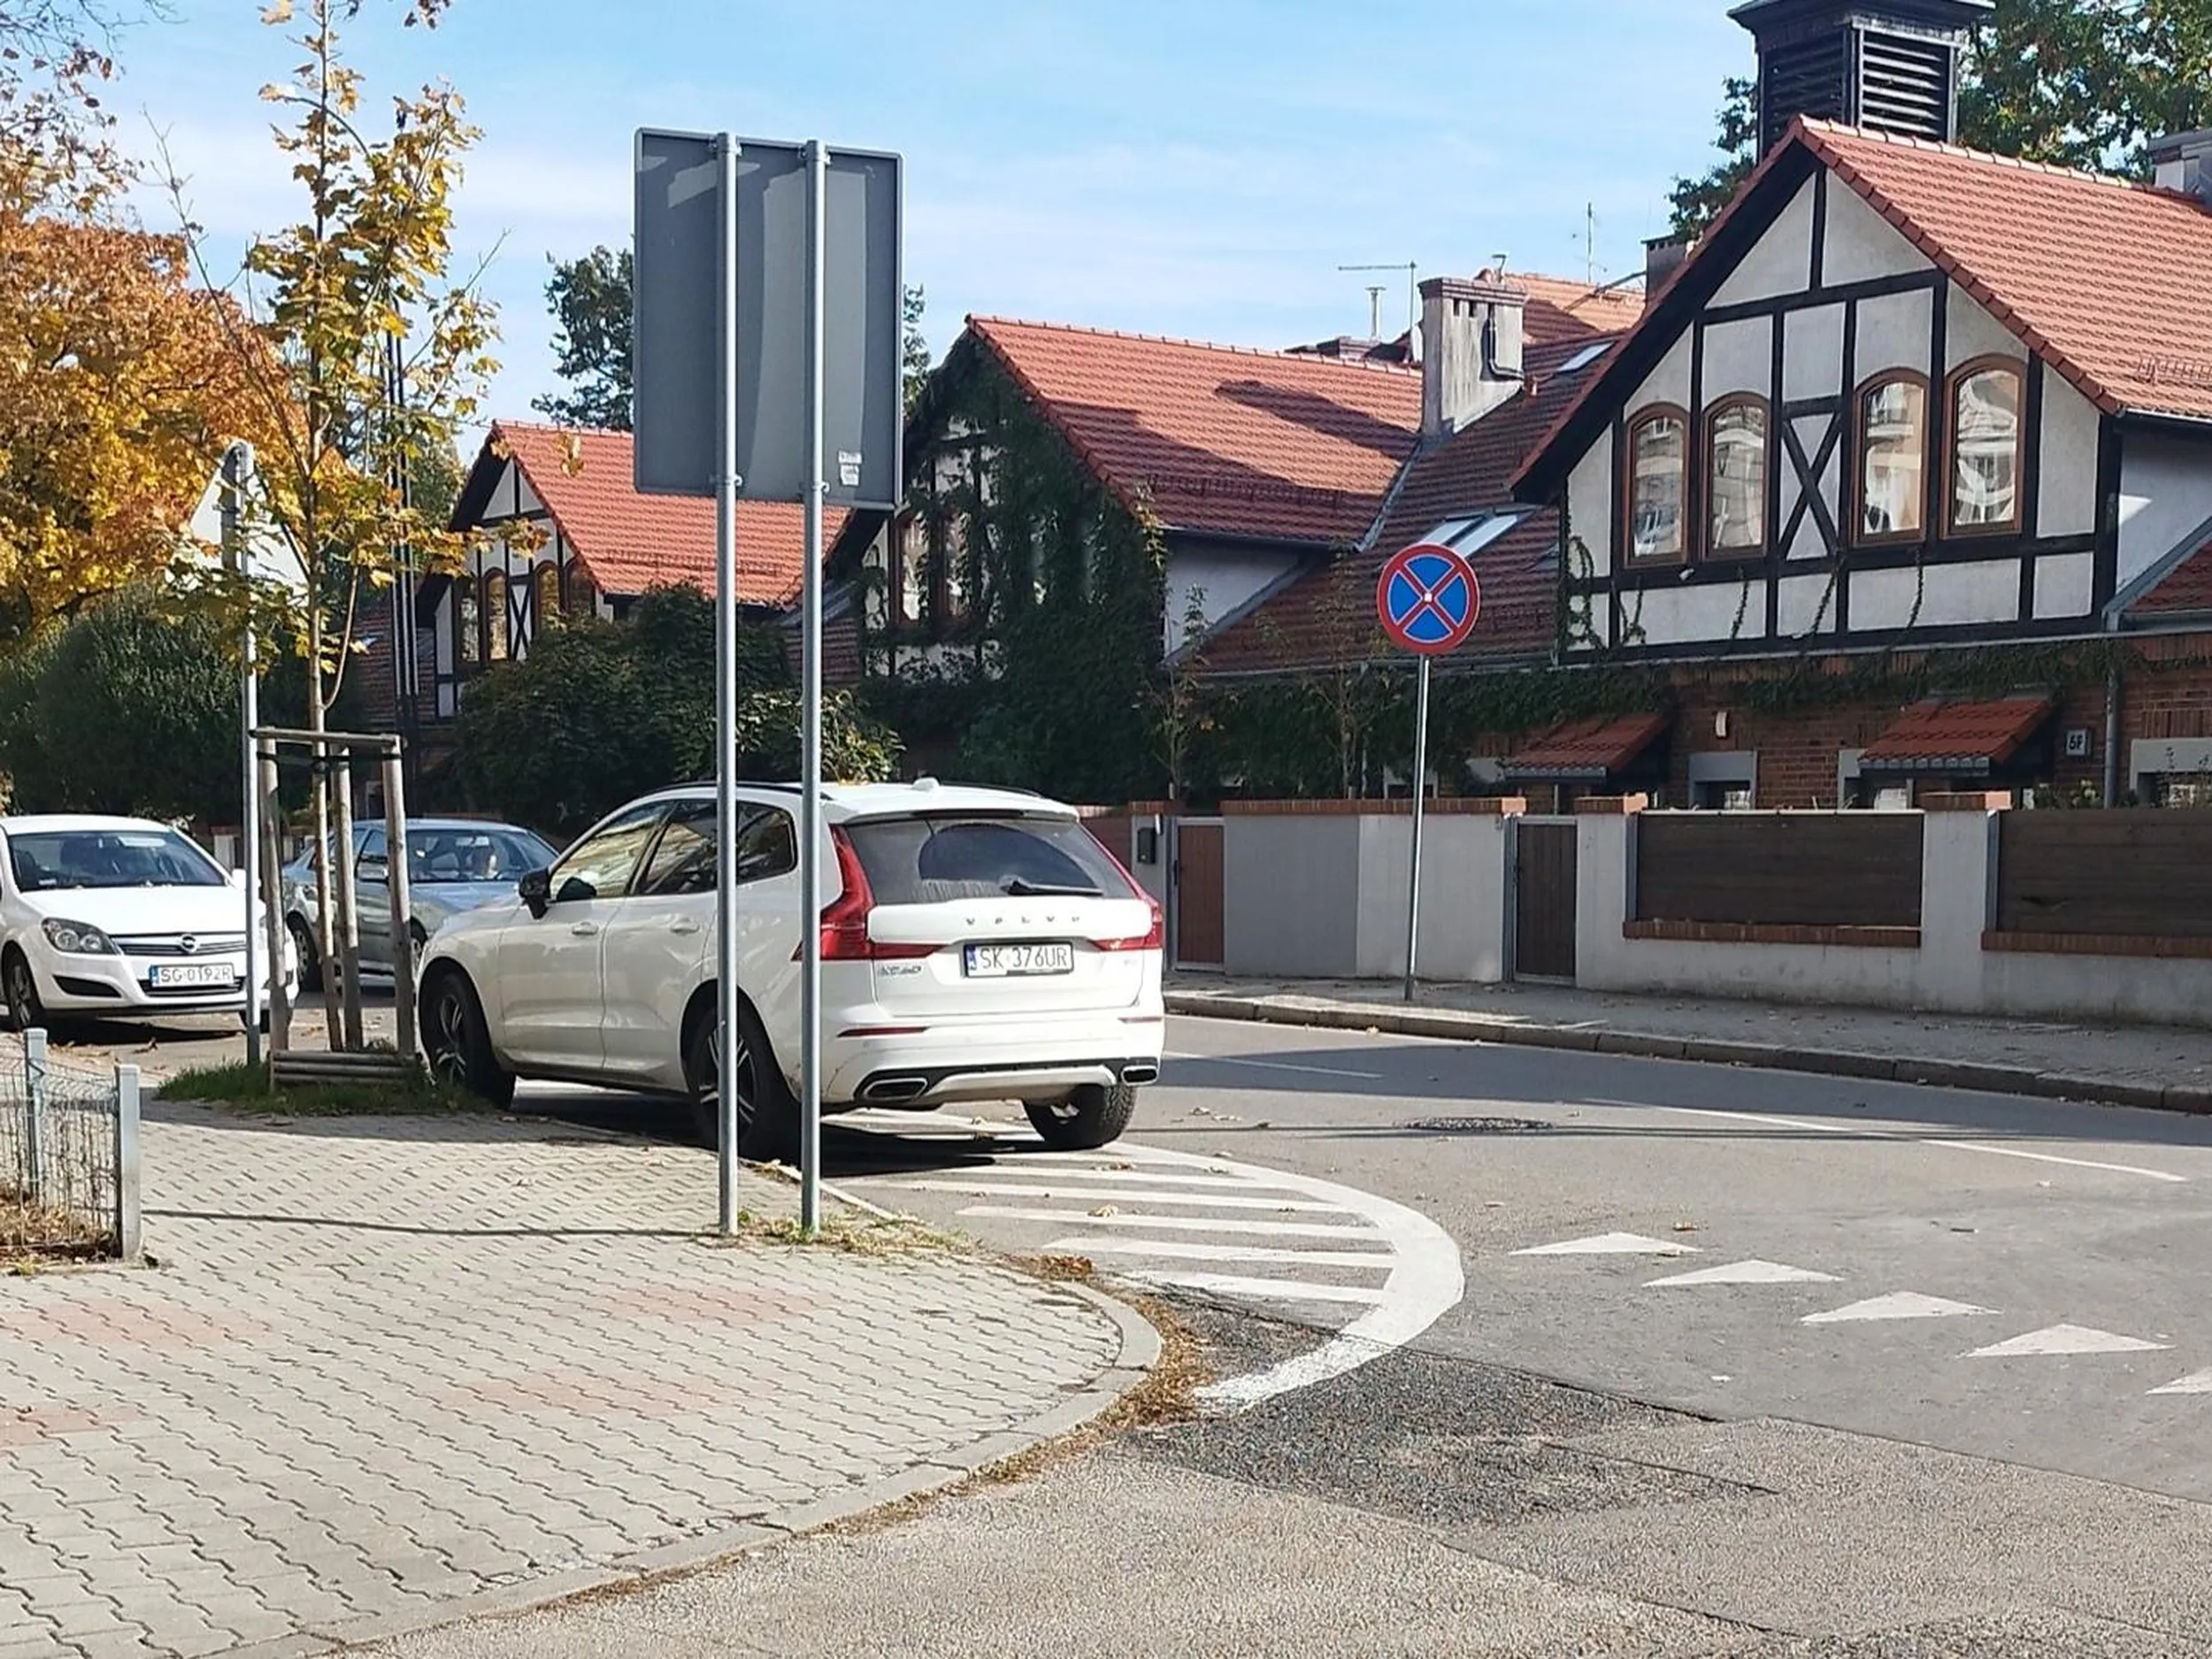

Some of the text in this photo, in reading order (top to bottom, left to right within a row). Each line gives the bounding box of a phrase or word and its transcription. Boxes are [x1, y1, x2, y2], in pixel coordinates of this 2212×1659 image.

[979, 946, 1068, 969] SK 376UR
[160, 968, 183, 983] SG
